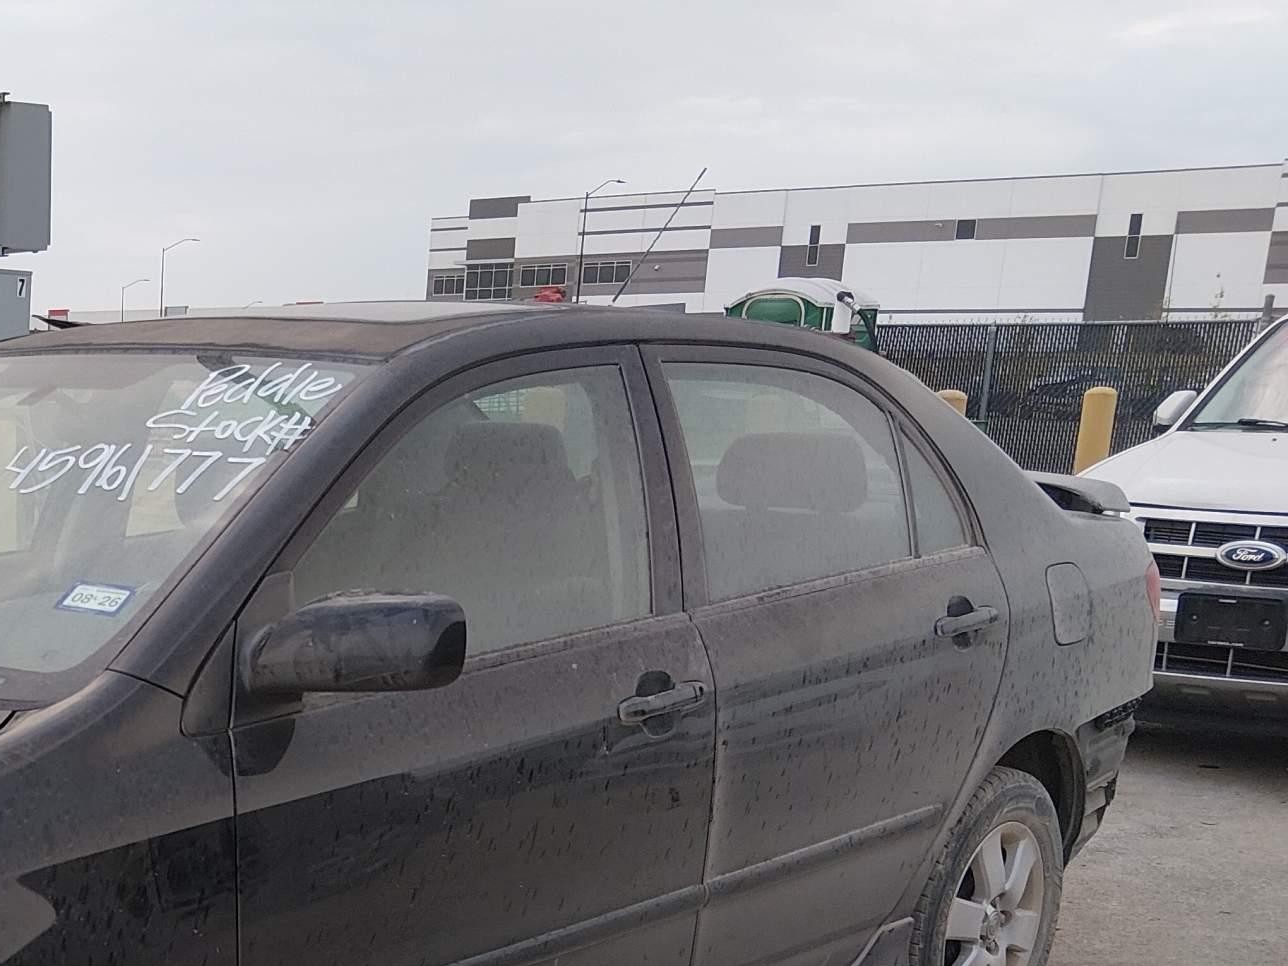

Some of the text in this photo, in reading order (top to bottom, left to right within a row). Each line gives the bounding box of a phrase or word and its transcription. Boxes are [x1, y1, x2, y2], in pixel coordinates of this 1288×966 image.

[18, 278, 25, 296] 7
[181, 362, 343, 410] Peddle
[145, 410, 314, 454] Stock#
[6, 442, 266, 501] 45961777
[1232, 547, 1265, 561] Ford
